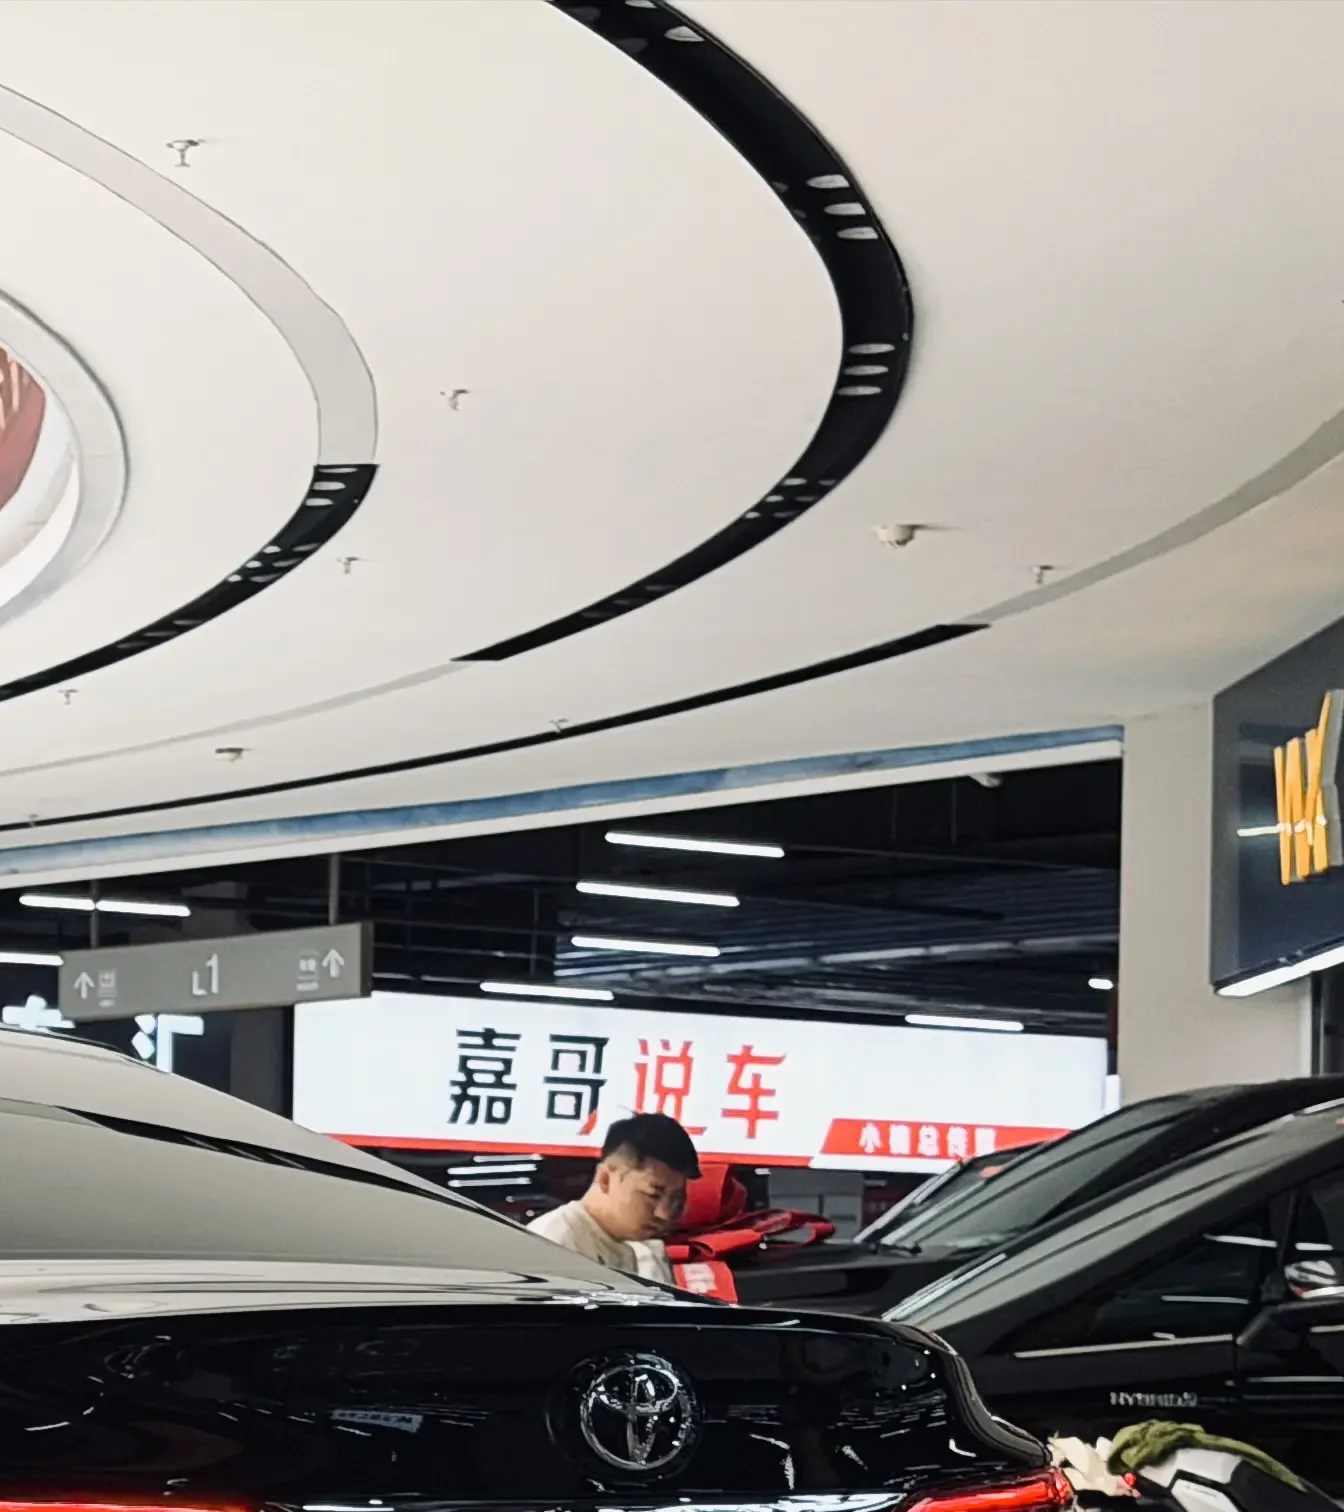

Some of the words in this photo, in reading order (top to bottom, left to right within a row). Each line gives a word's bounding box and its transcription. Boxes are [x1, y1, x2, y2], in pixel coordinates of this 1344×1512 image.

[192, 953, 219, 996] L1
[448, 1026, 789, 1140] 嘉哥说车
